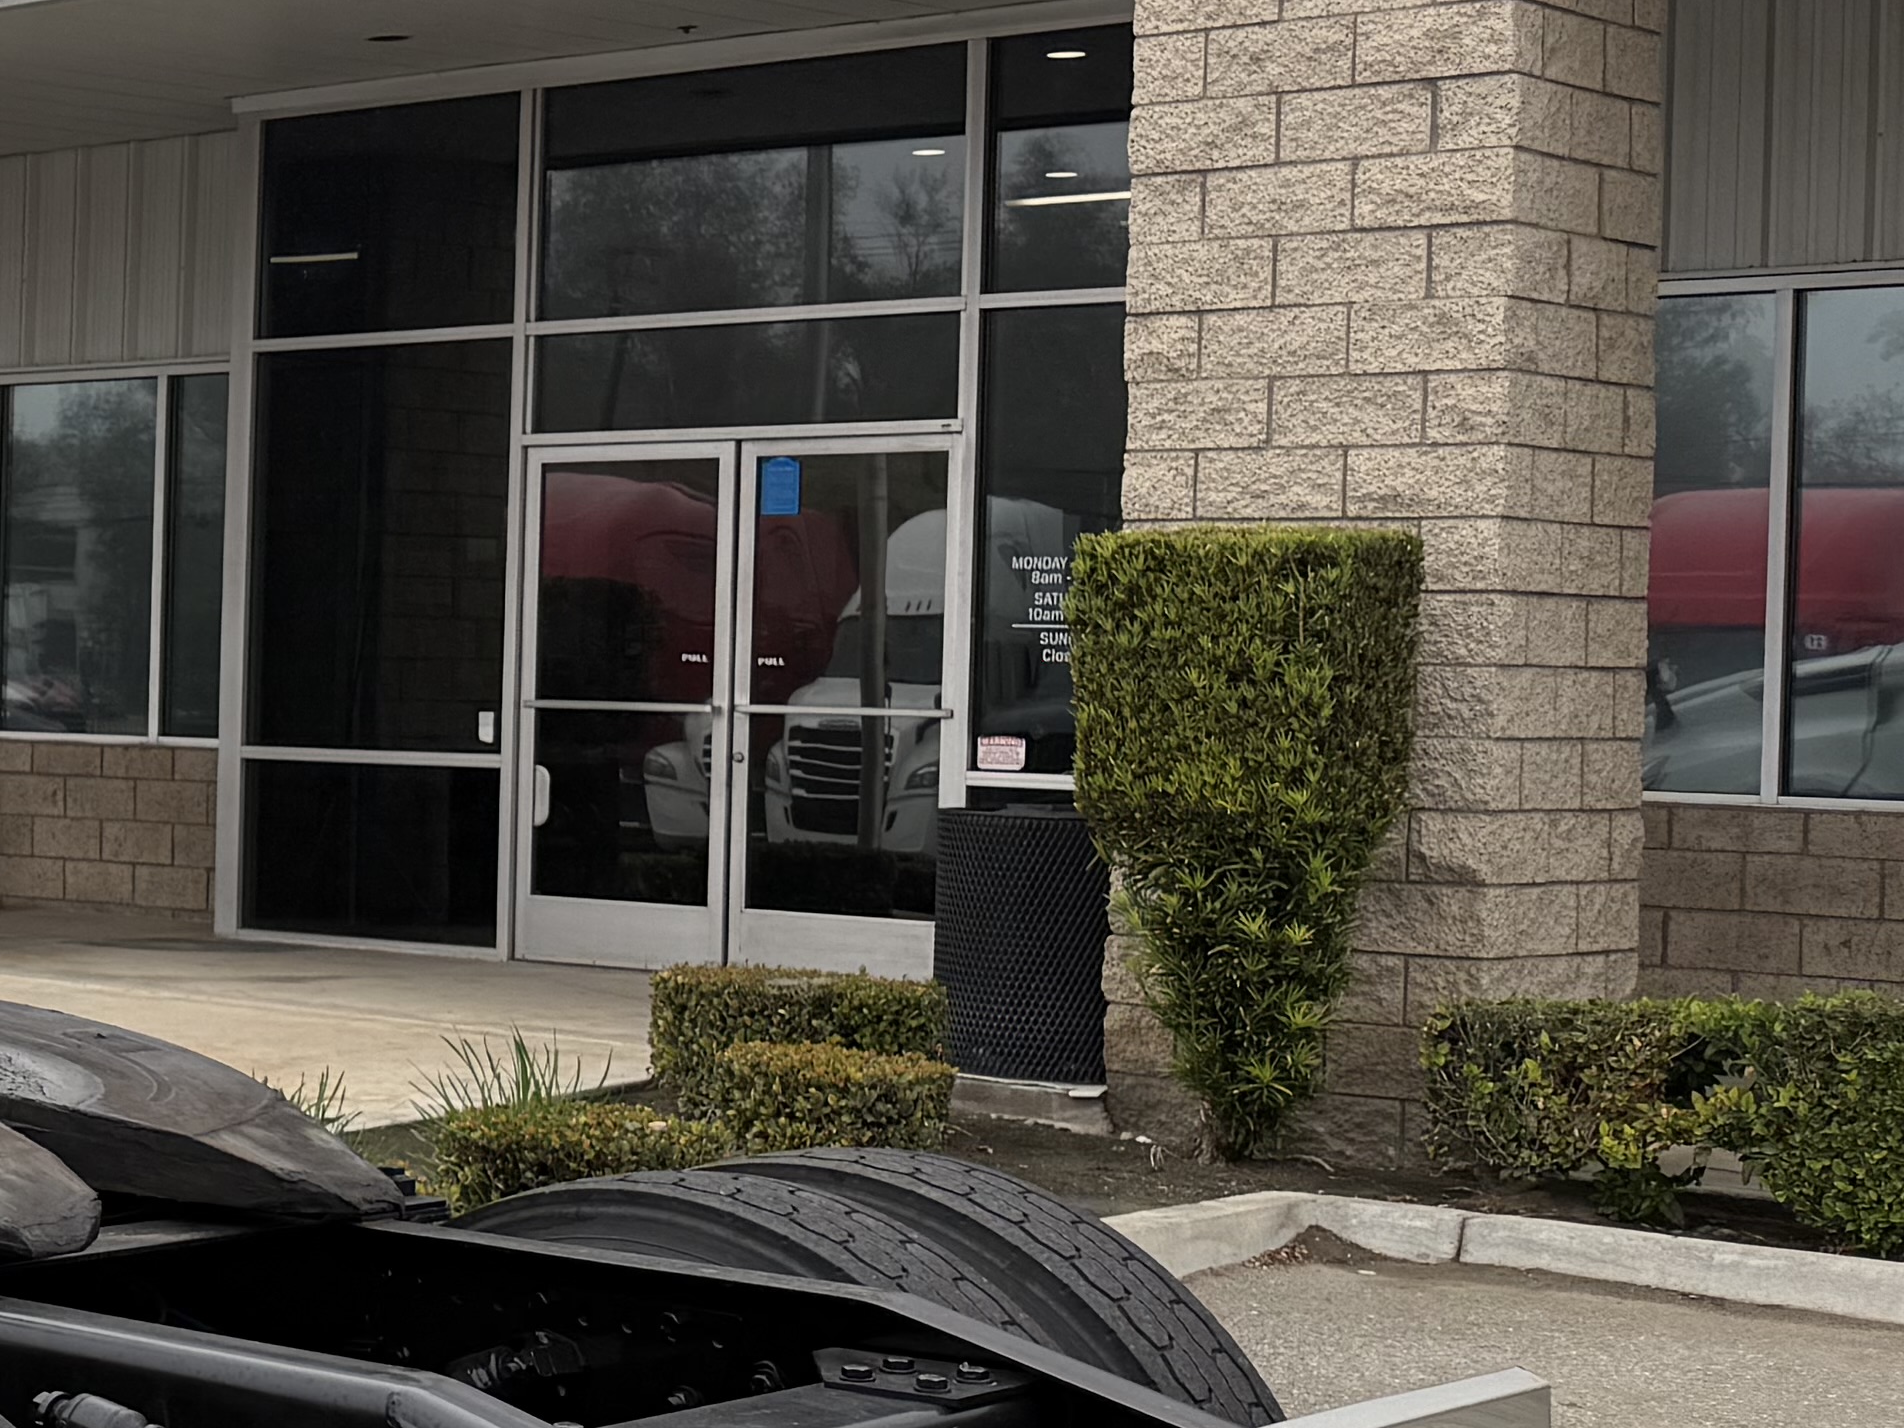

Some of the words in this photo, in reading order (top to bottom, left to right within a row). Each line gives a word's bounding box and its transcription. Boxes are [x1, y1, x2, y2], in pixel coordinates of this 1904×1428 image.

[1012, 556, 1068, 570] MONDAY
[1031, 571, 1062, 584] 8am
[1029, 608, 1064, 621] 10am
[681, 653, 709, 663] PULL
[758, 657, 785, 666] PULL
